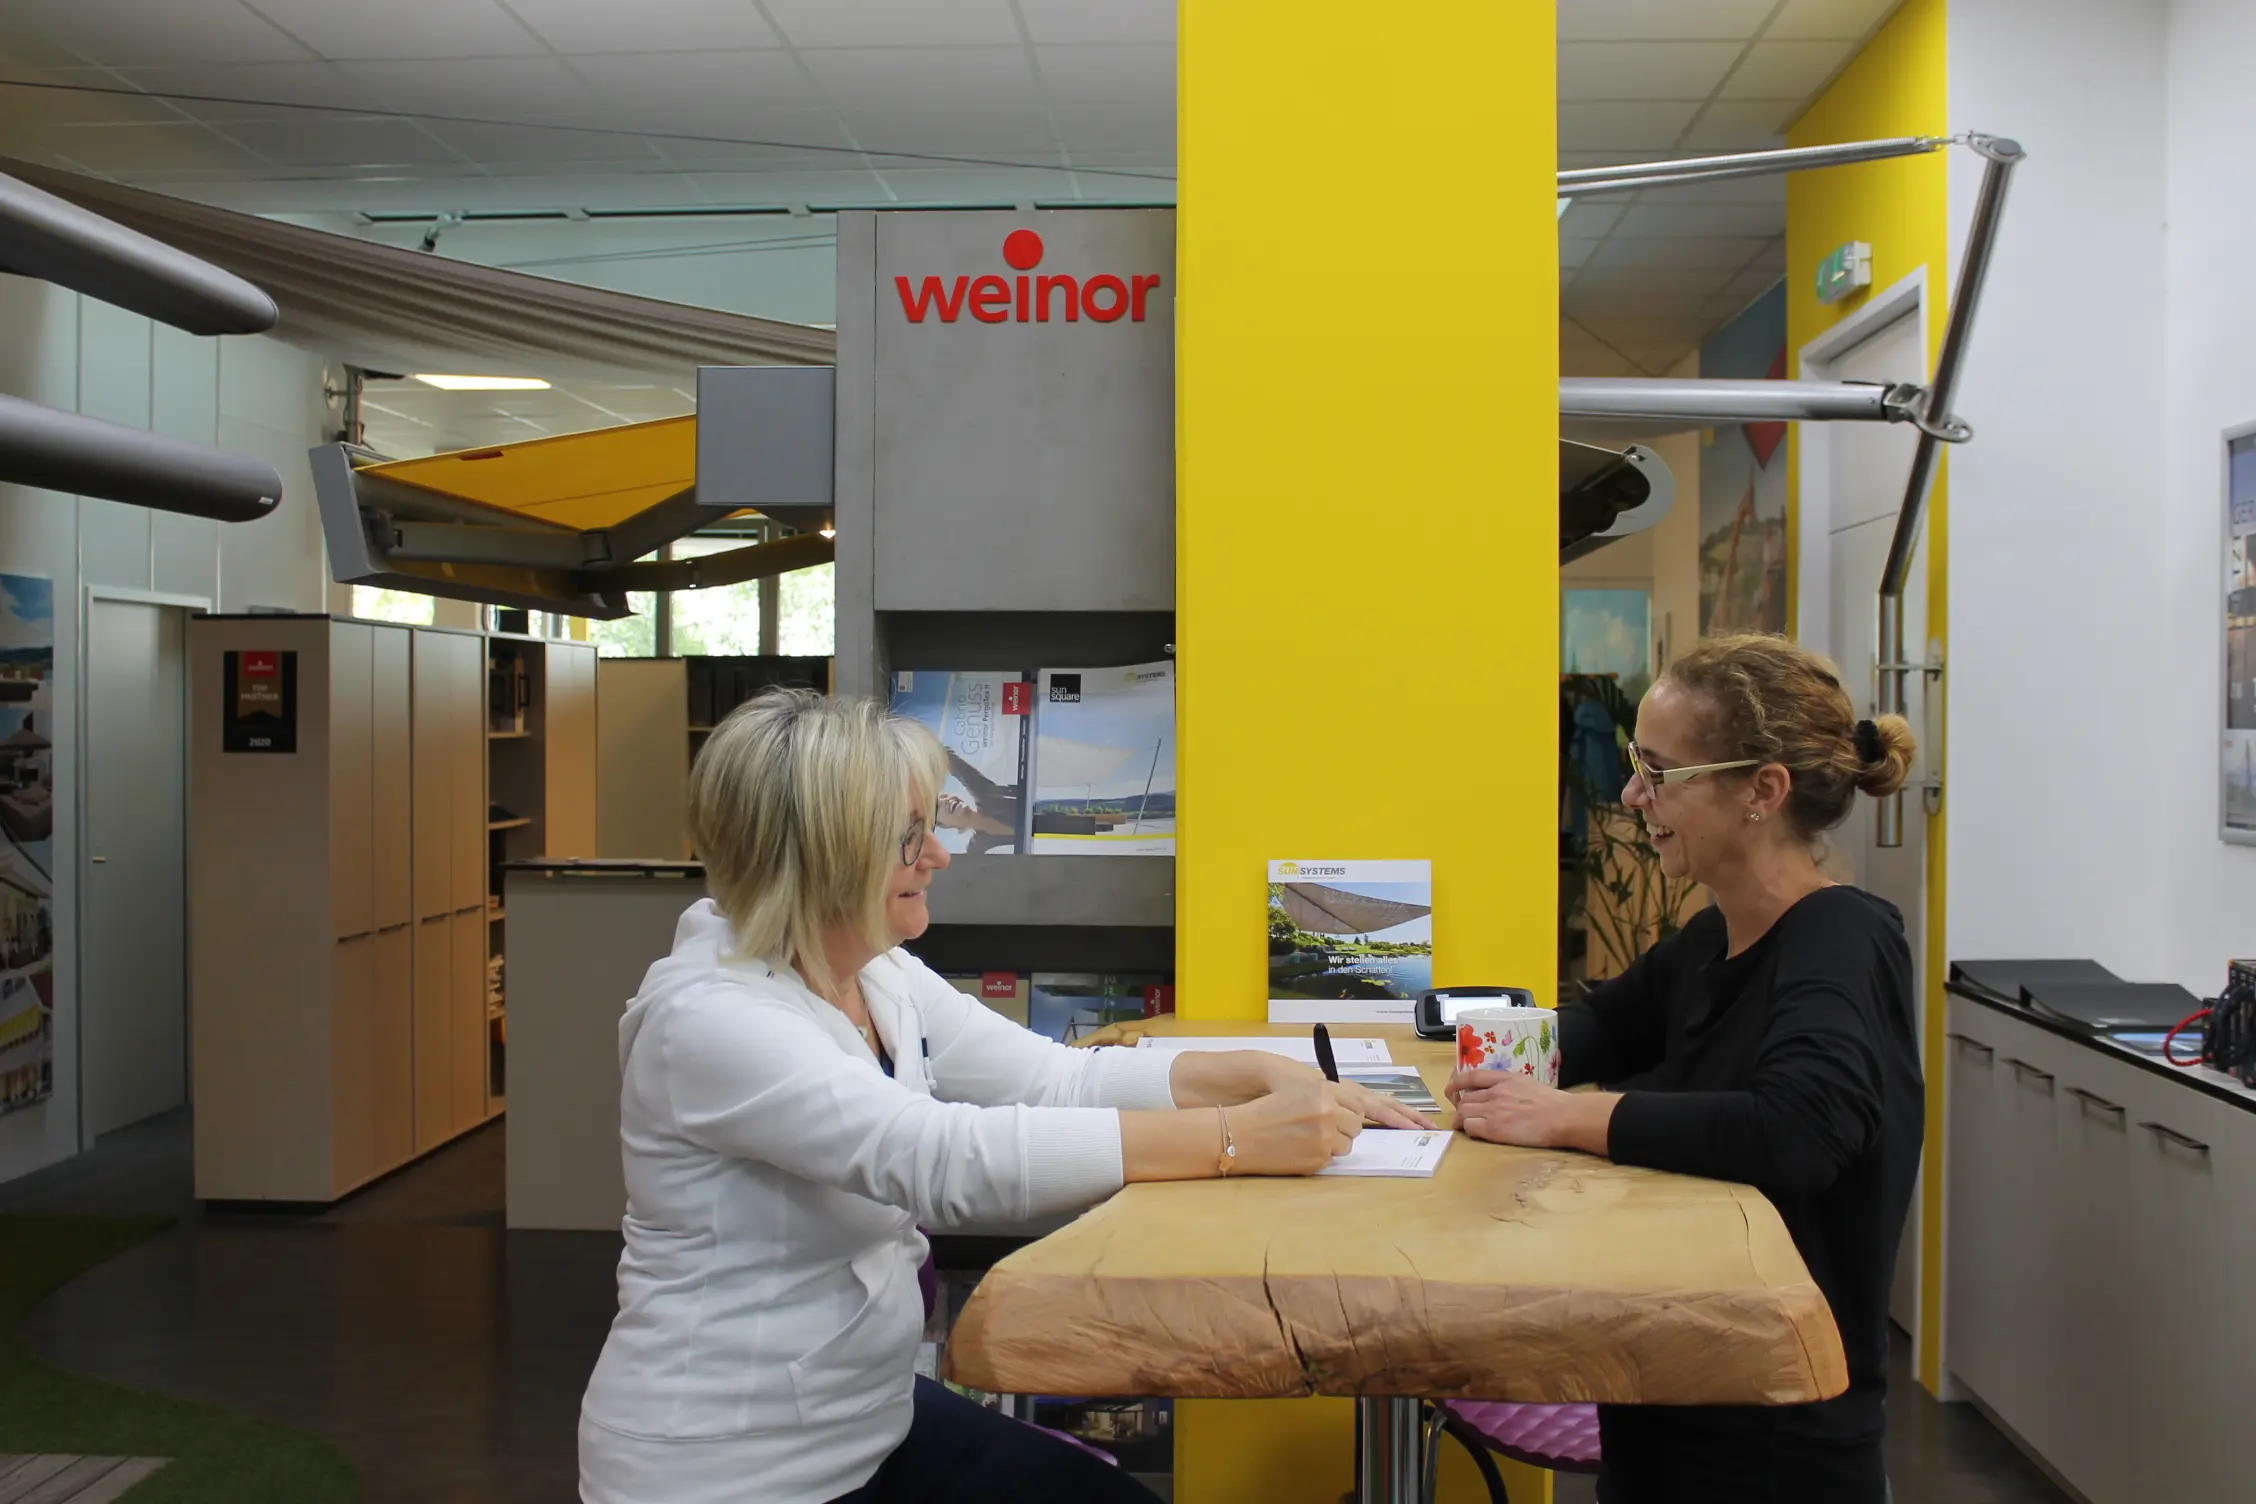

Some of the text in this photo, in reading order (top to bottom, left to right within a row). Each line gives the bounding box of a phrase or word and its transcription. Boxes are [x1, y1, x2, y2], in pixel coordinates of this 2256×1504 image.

[895, 229, 1160, 323] weinor
[241, 692, 279, 701] PARTNER
[1008, 686, 1019, 712] weinor
[1050, 693, 1080, 702] square
[954, 695, 966, 736] Cabrio
[961, 682, 982, 755] Genuss
[249, 738, 271, 747] 2020
[1300, 867, 1346, 876] SYSTEMS
[1328, 954, 1399, 964] Wir stellen alles
[1328, 966, 1393, 975] in den Schatten!
[986, 980, 1012, 991] weinor
